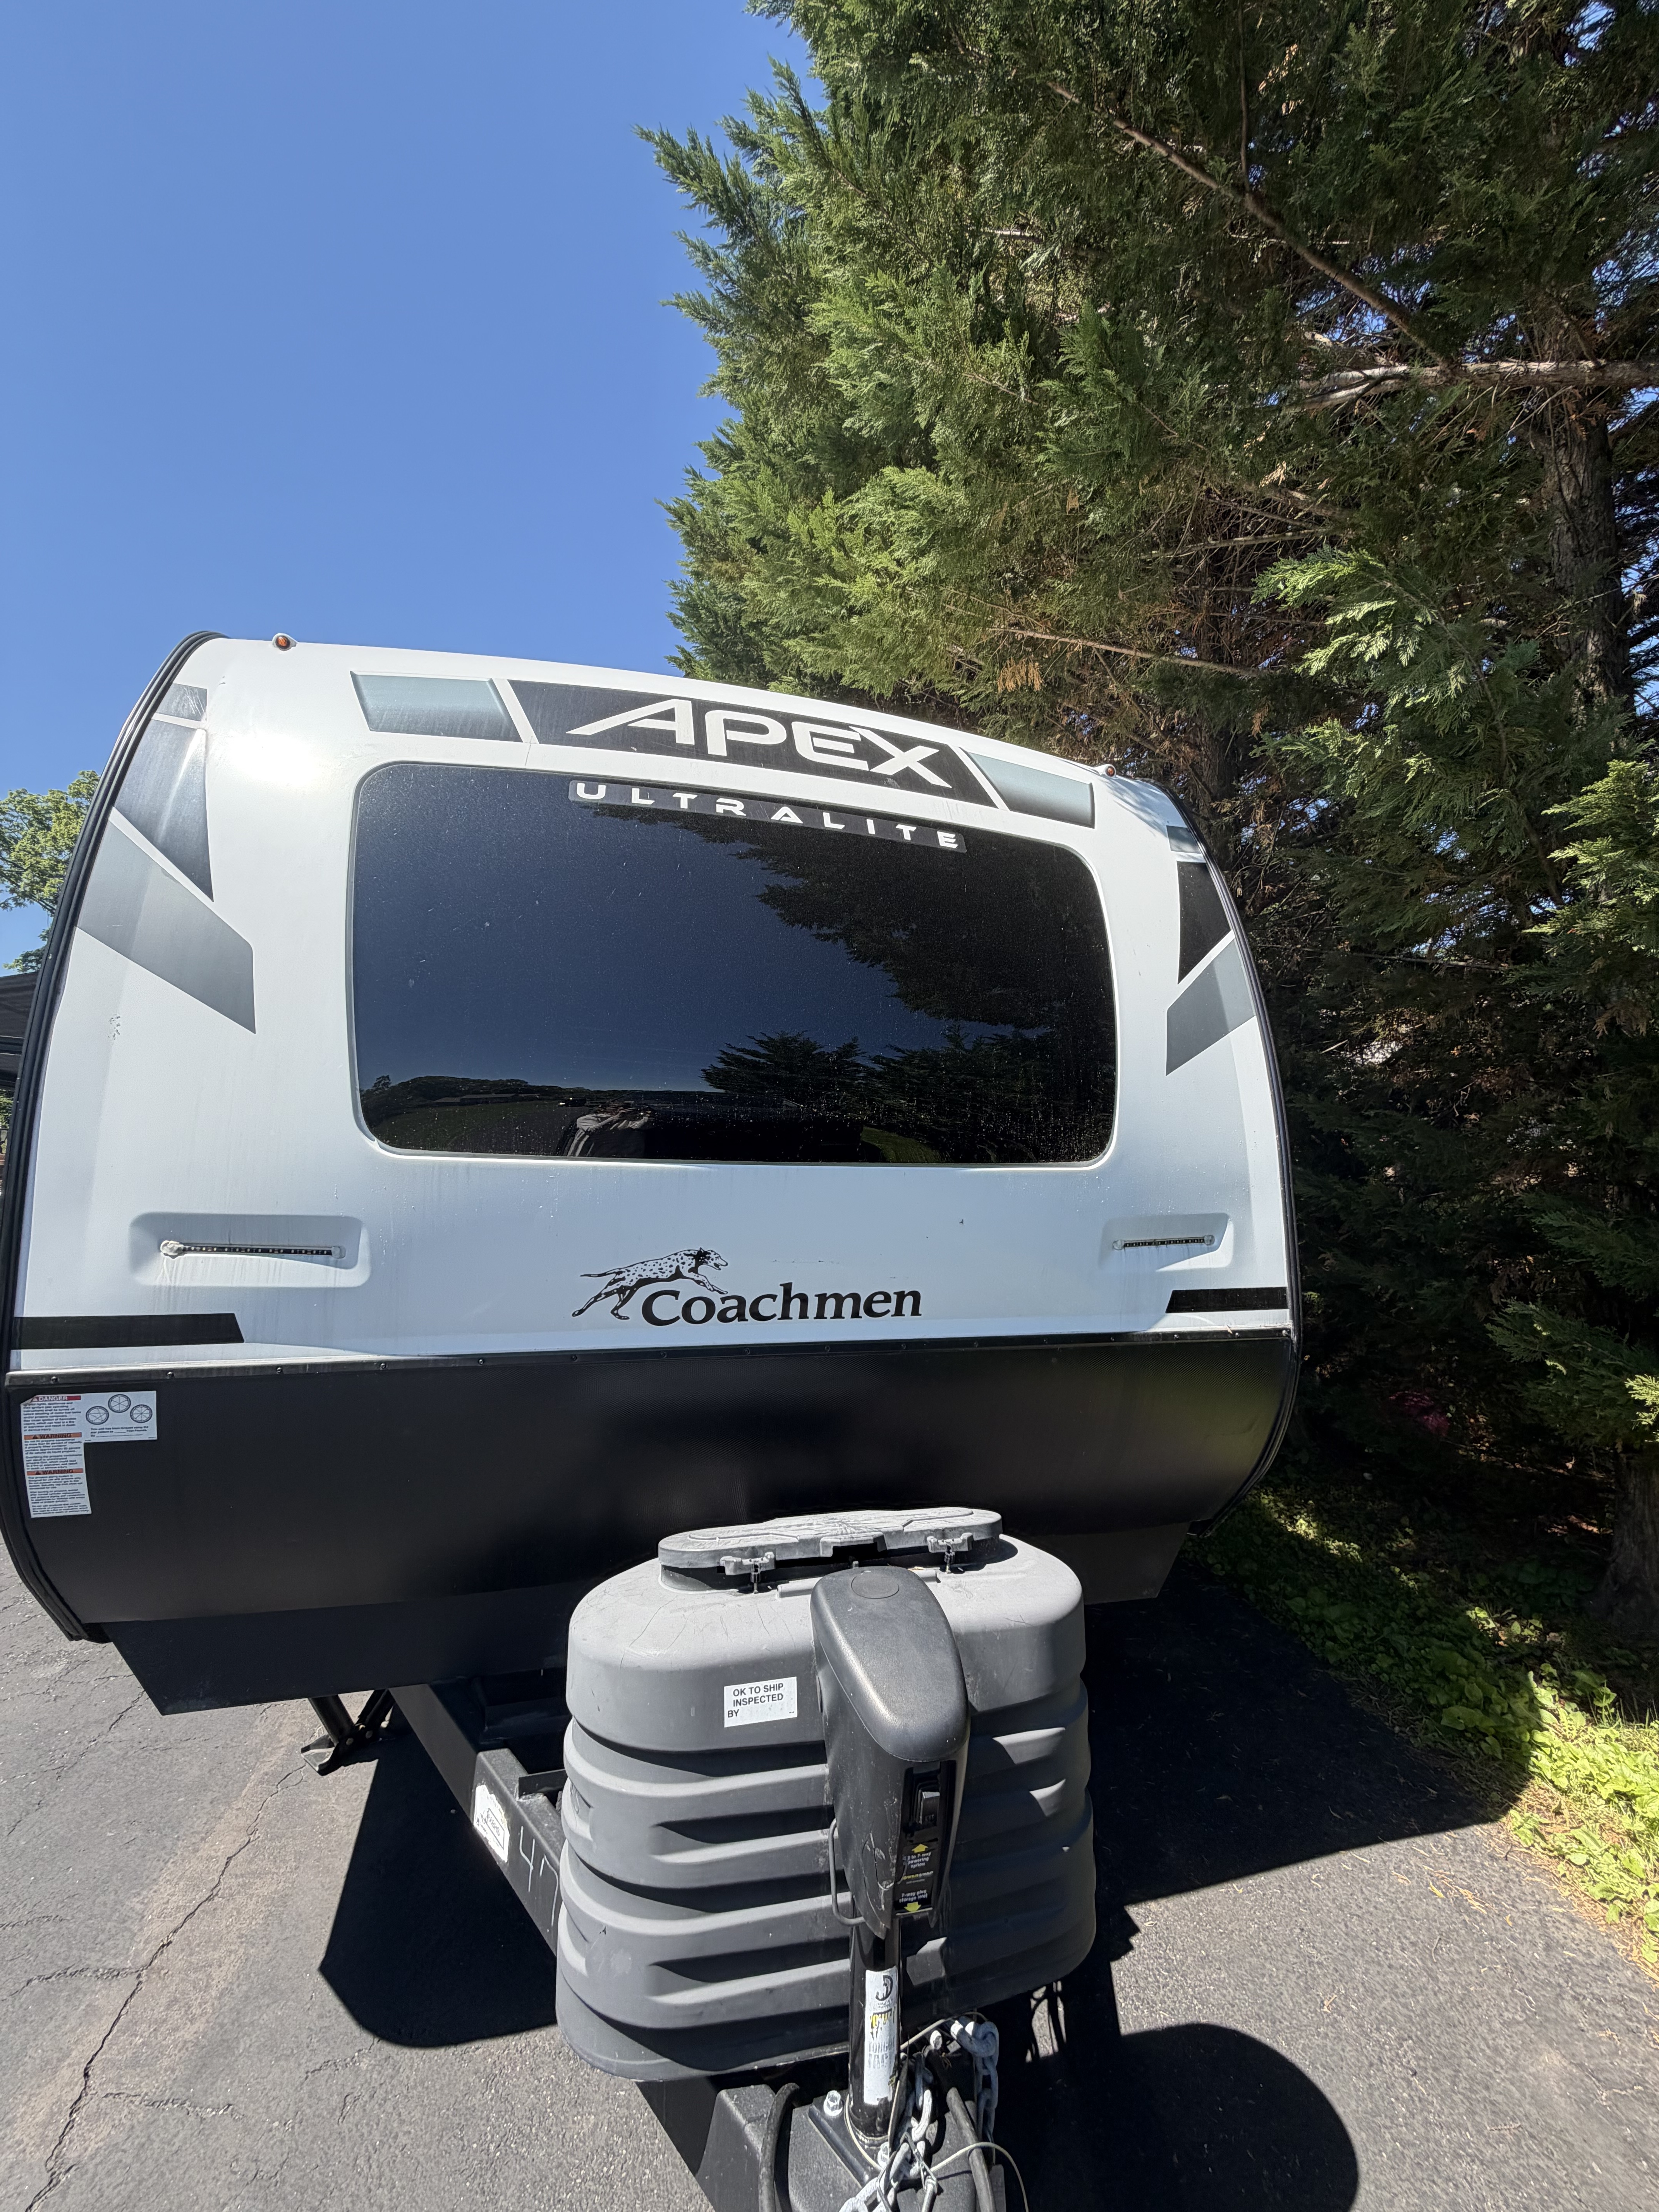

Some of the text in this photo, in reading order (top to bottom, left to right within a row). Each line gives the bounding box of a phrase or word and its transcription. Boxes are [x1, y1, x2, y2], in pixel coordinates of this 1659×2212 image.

[566, 699, 952, 788] APEX
[576, 783, 958, 848] ULTRALITE
[641, 1282, 922, 1326] Coachmen
[733, 1683, 783, 1697] OK TO SHIP
[733, 1693, 783, 1707] INSPECTED
[728, 1709, 740, 1718] BY
